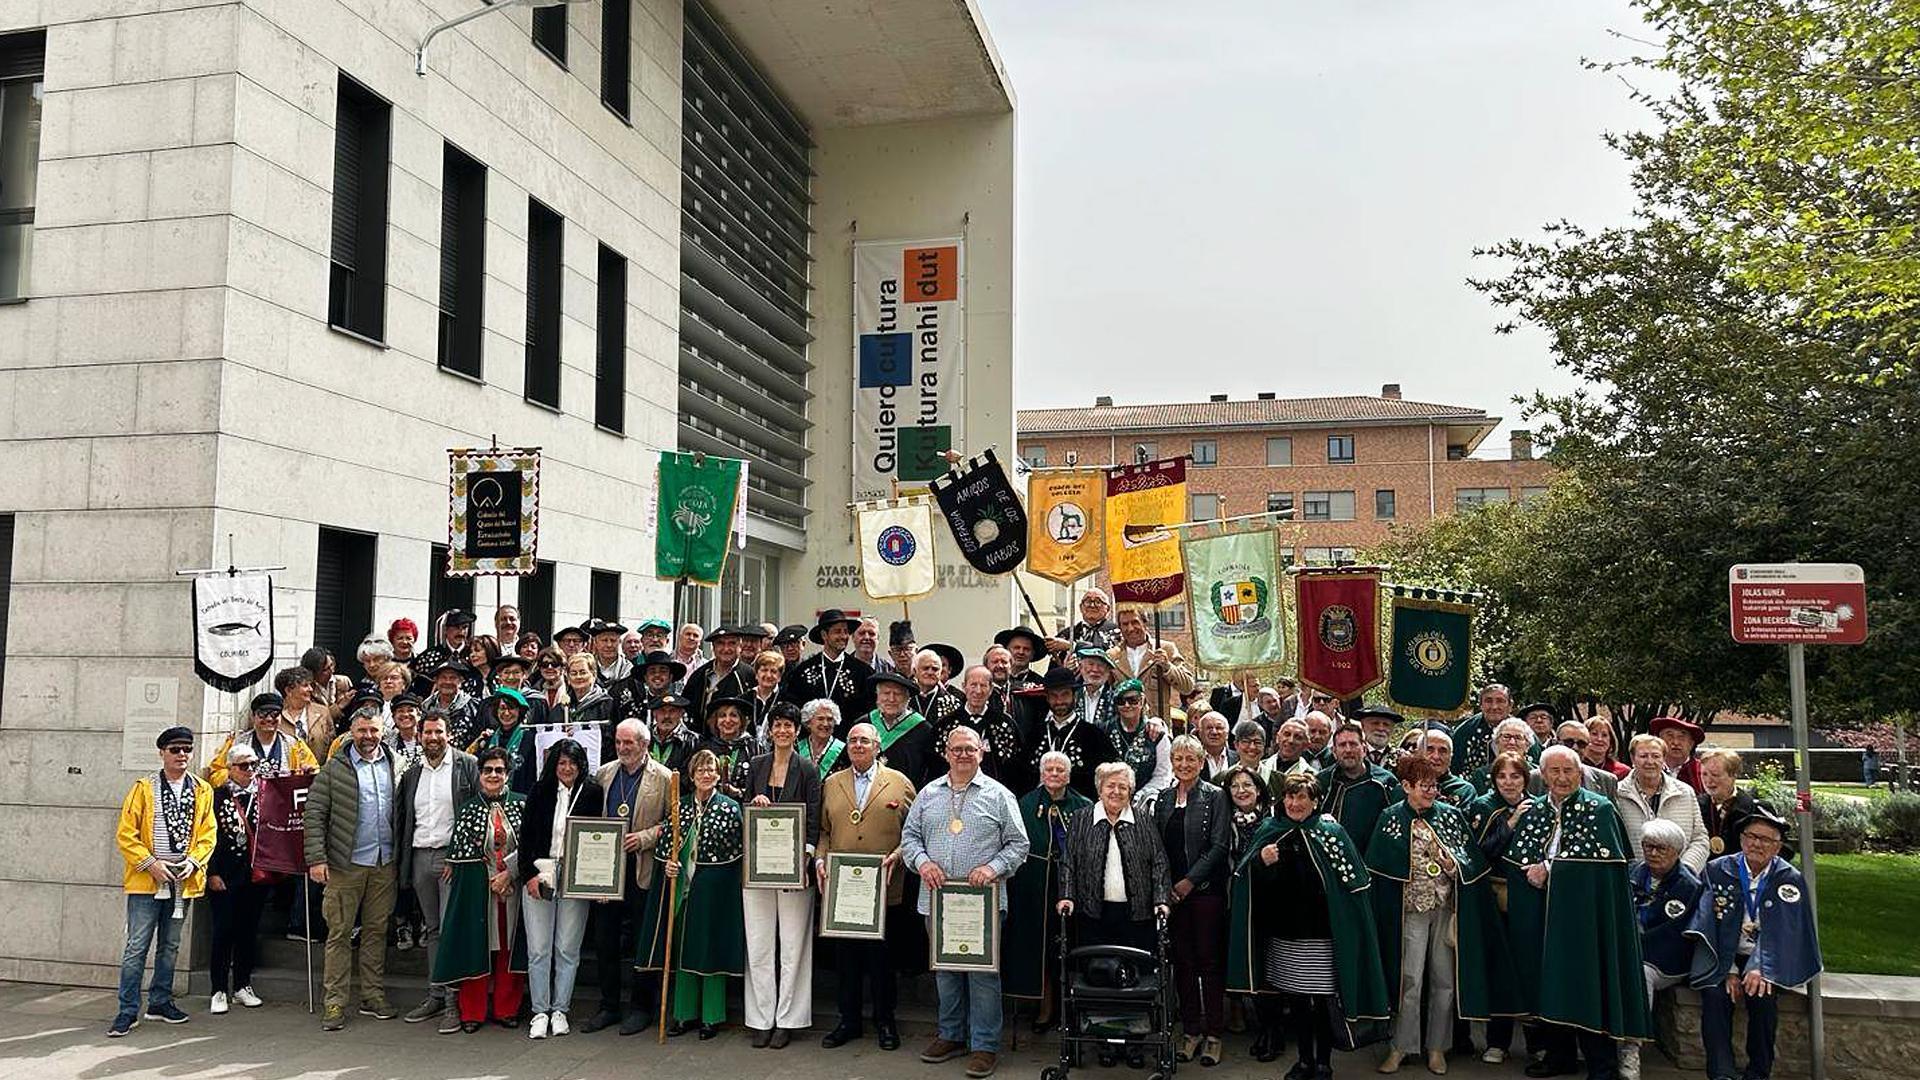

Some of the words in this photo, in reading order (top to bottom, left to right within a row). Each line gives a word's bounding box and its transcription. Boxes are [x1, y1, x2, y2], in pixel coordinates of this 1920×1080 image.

[916, 251, 938, 296] dut
[877, 279, 897, 375] cultura
[916, 305, 938, 363] nahi
[874, 383, 897, 474] Quiero
[916, 371, 938, 471] Kultura
[956, 476, 990, 504] AMIGOS
[995, 489, 1010, 504] DE
[1003, 507, 1020, 524] LOS
[985, 540, 1020, 567] NABOS
[816, 577, 849, 588] CASA
[852, 577, 861, 588] D
[1742, 588, 1761, 596] JOLAS
[1763, 588, 1785, 596] GUNEA
[1743, 616, 1761, 625] ZONA
[1763, 616, 1792, 625] RECREA
